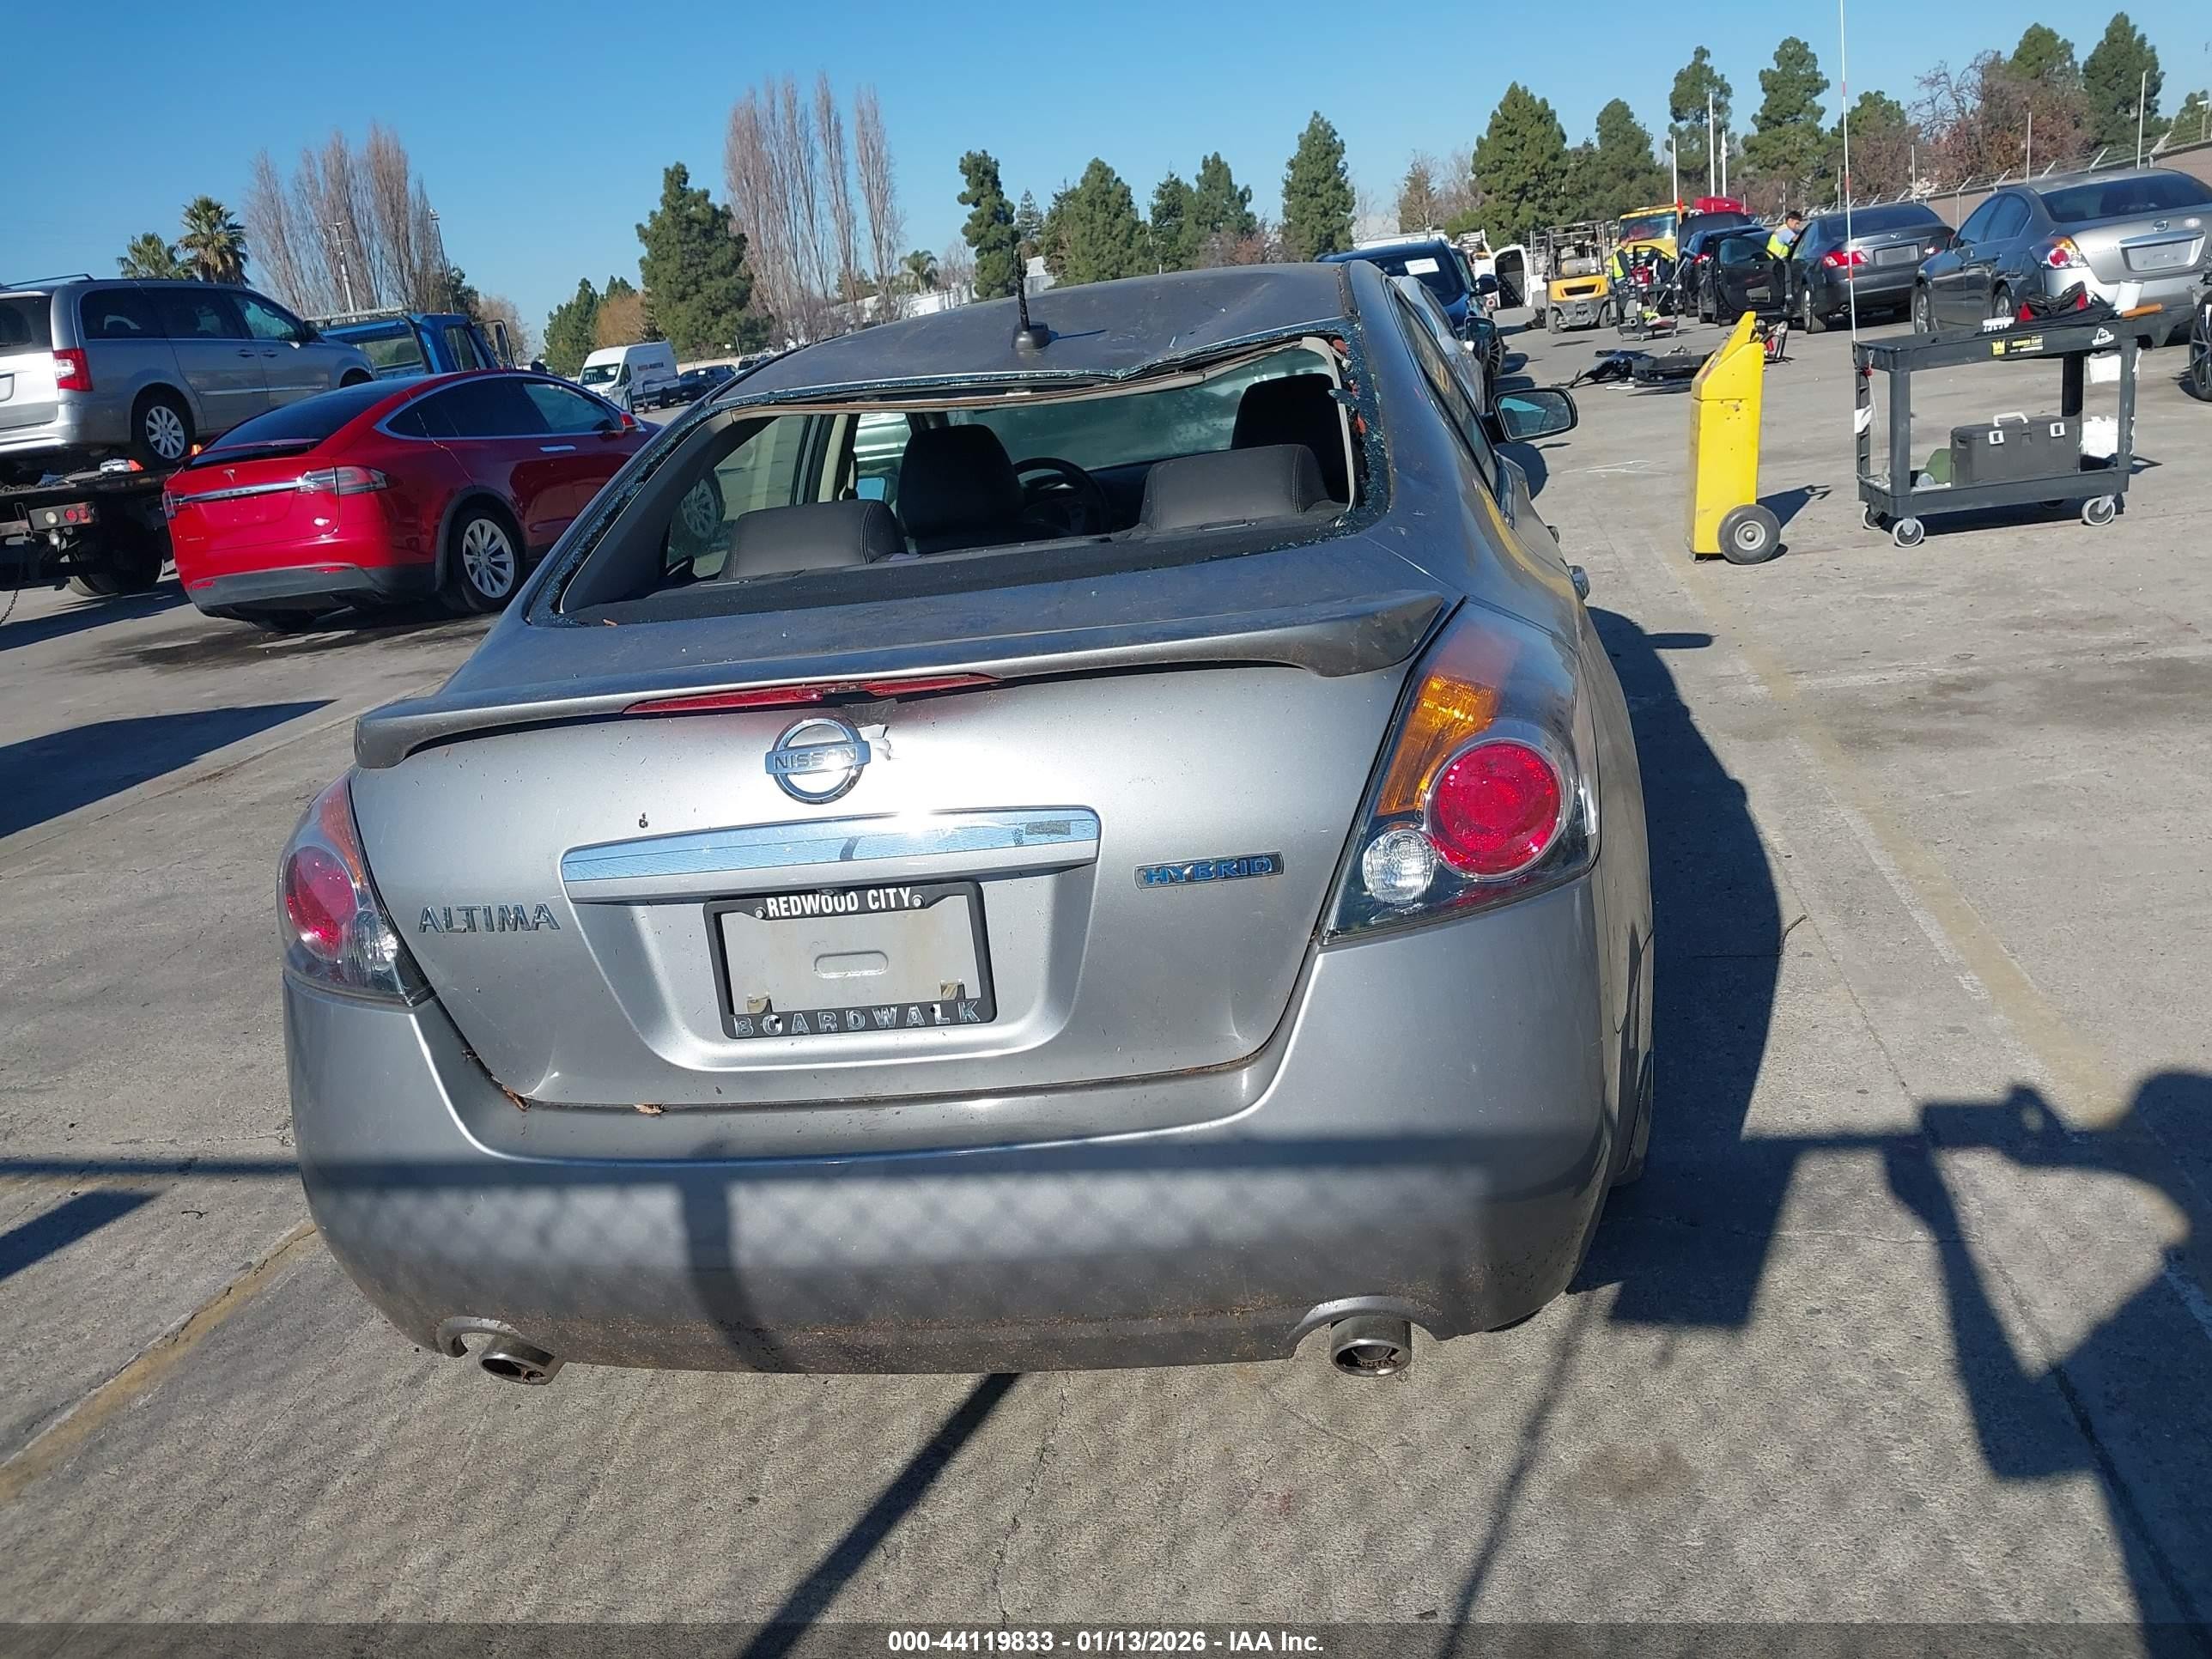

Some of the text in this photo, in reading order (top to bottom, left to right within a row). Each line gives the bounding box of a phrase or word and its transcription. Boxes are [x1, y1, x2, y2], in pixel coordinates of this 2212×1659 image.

[1145, 856, 1273, 885] HYBRID
[766, 886, 911, 917] REDWOOD CITY
[418, 903, 561, 933] ALTIMA
[733, 1000, 981, 1036] BOARDWALK
